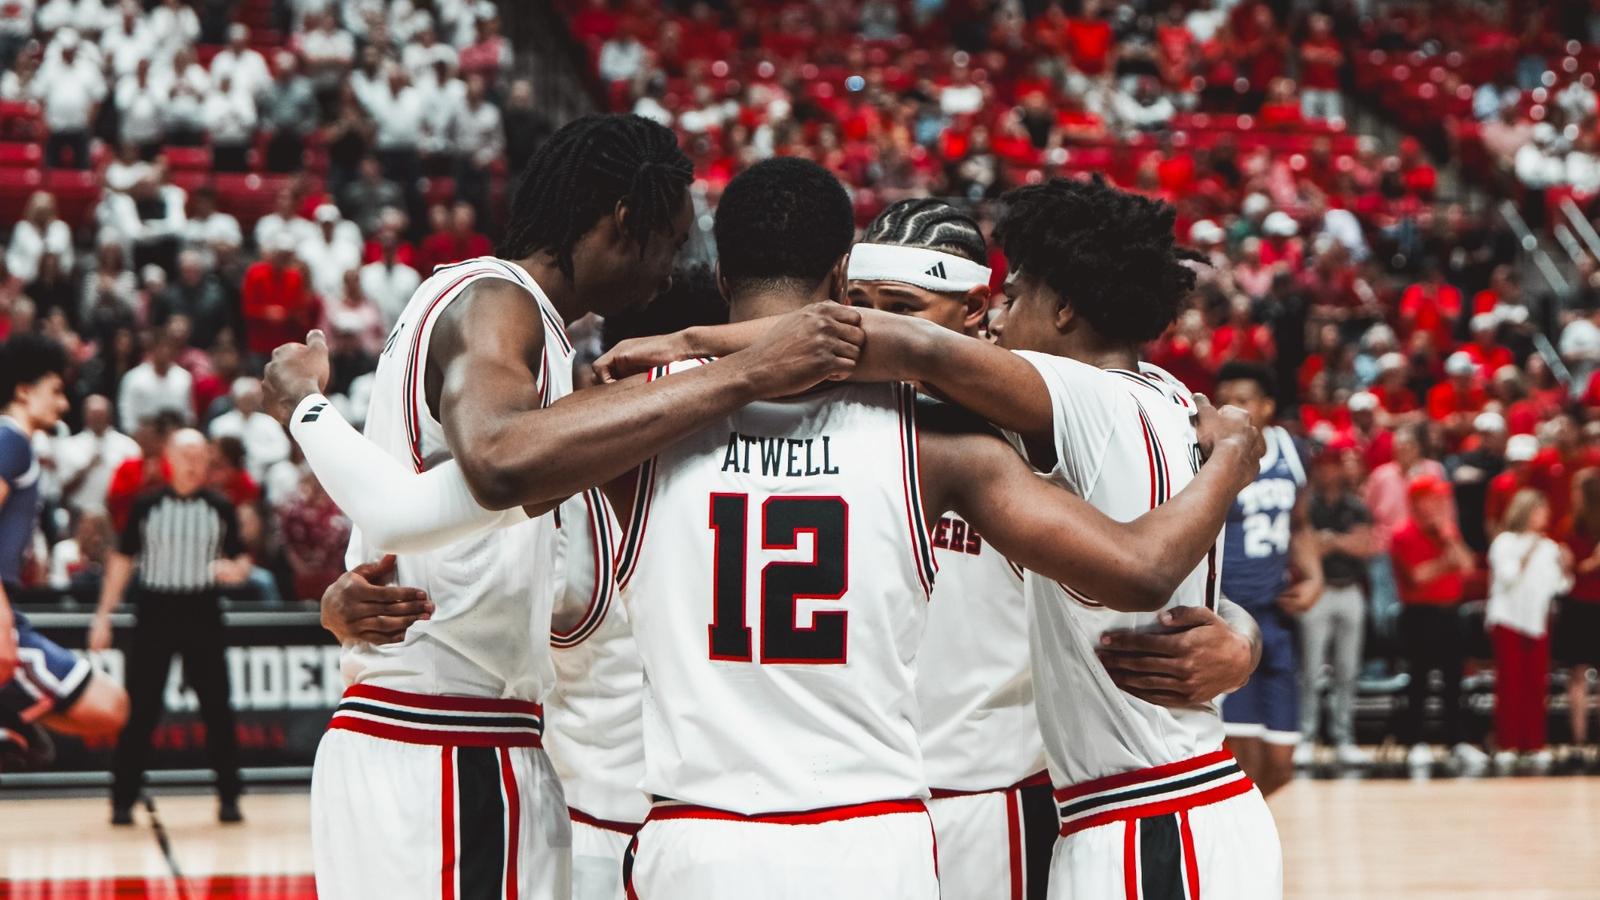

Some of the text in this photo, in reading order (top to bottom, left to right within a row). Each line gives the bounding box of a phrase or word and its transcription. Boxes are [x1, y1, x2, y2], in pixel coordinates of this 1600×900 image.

[721, 431, 839, 477] ATWELL
[1243, 512, 1290, 557] 24
[708, 492, 849, 664] 12
